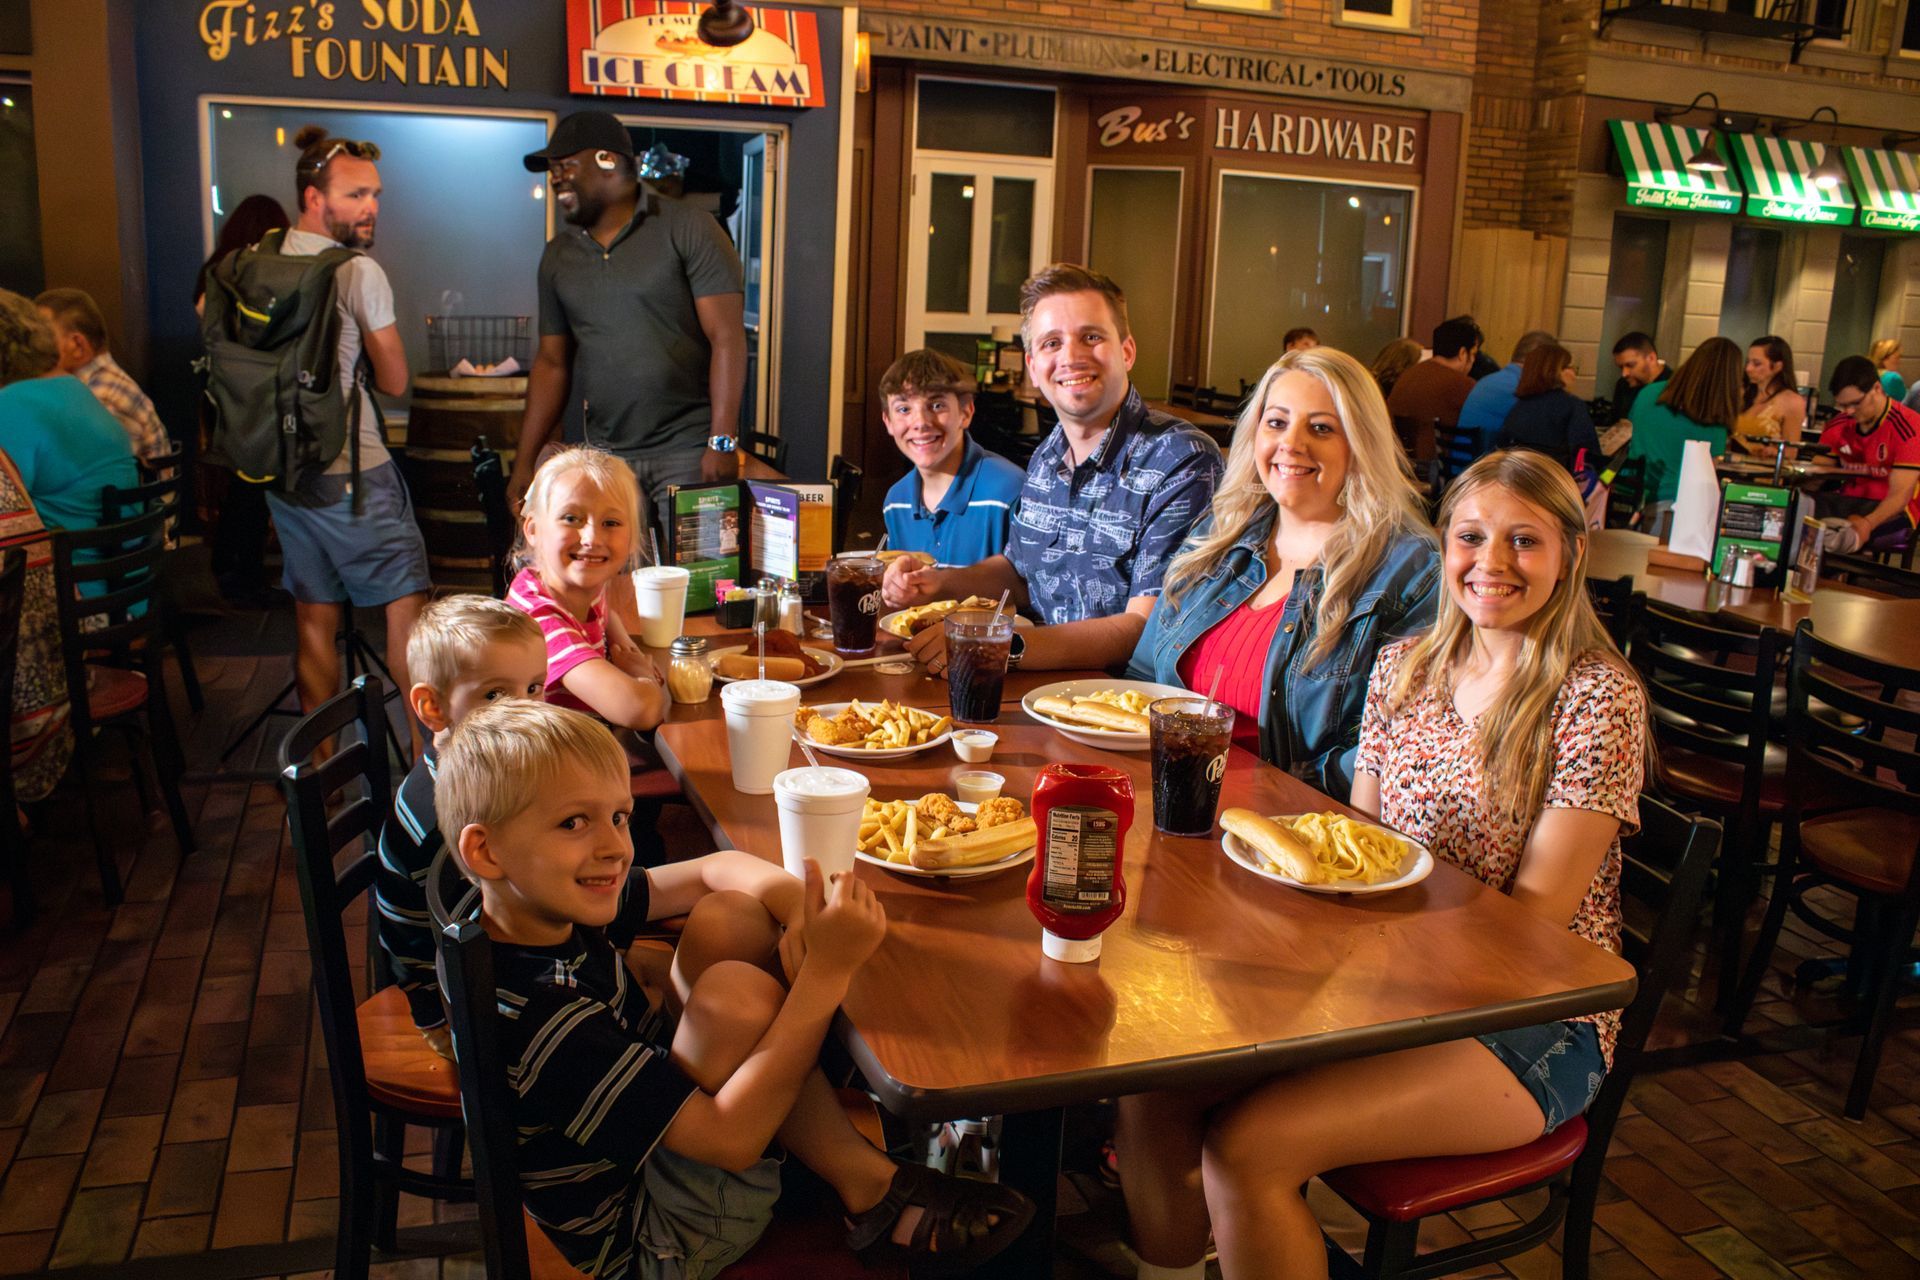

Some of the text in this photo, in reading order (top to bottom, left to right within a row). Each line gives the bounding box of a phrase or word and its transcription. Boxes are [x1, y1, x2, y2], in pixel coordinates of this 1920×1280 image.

[199, 0, 480, 61] Fizz's SODA
[291, 37, 508, 89] FOUNTAIN
[588, 56, 805, 95] ICE CREAM
[885, 22, 974, 53] PAINT
[1153, 48, 1313, 88] ELECTRICAL
[1327, 66, 1406, 97] TOOLS
[1097, 105, 1196, 148] Bus's
[1214, 107, 1417, 165] HARDWARE
[799, 493, 824, 502] BEER
